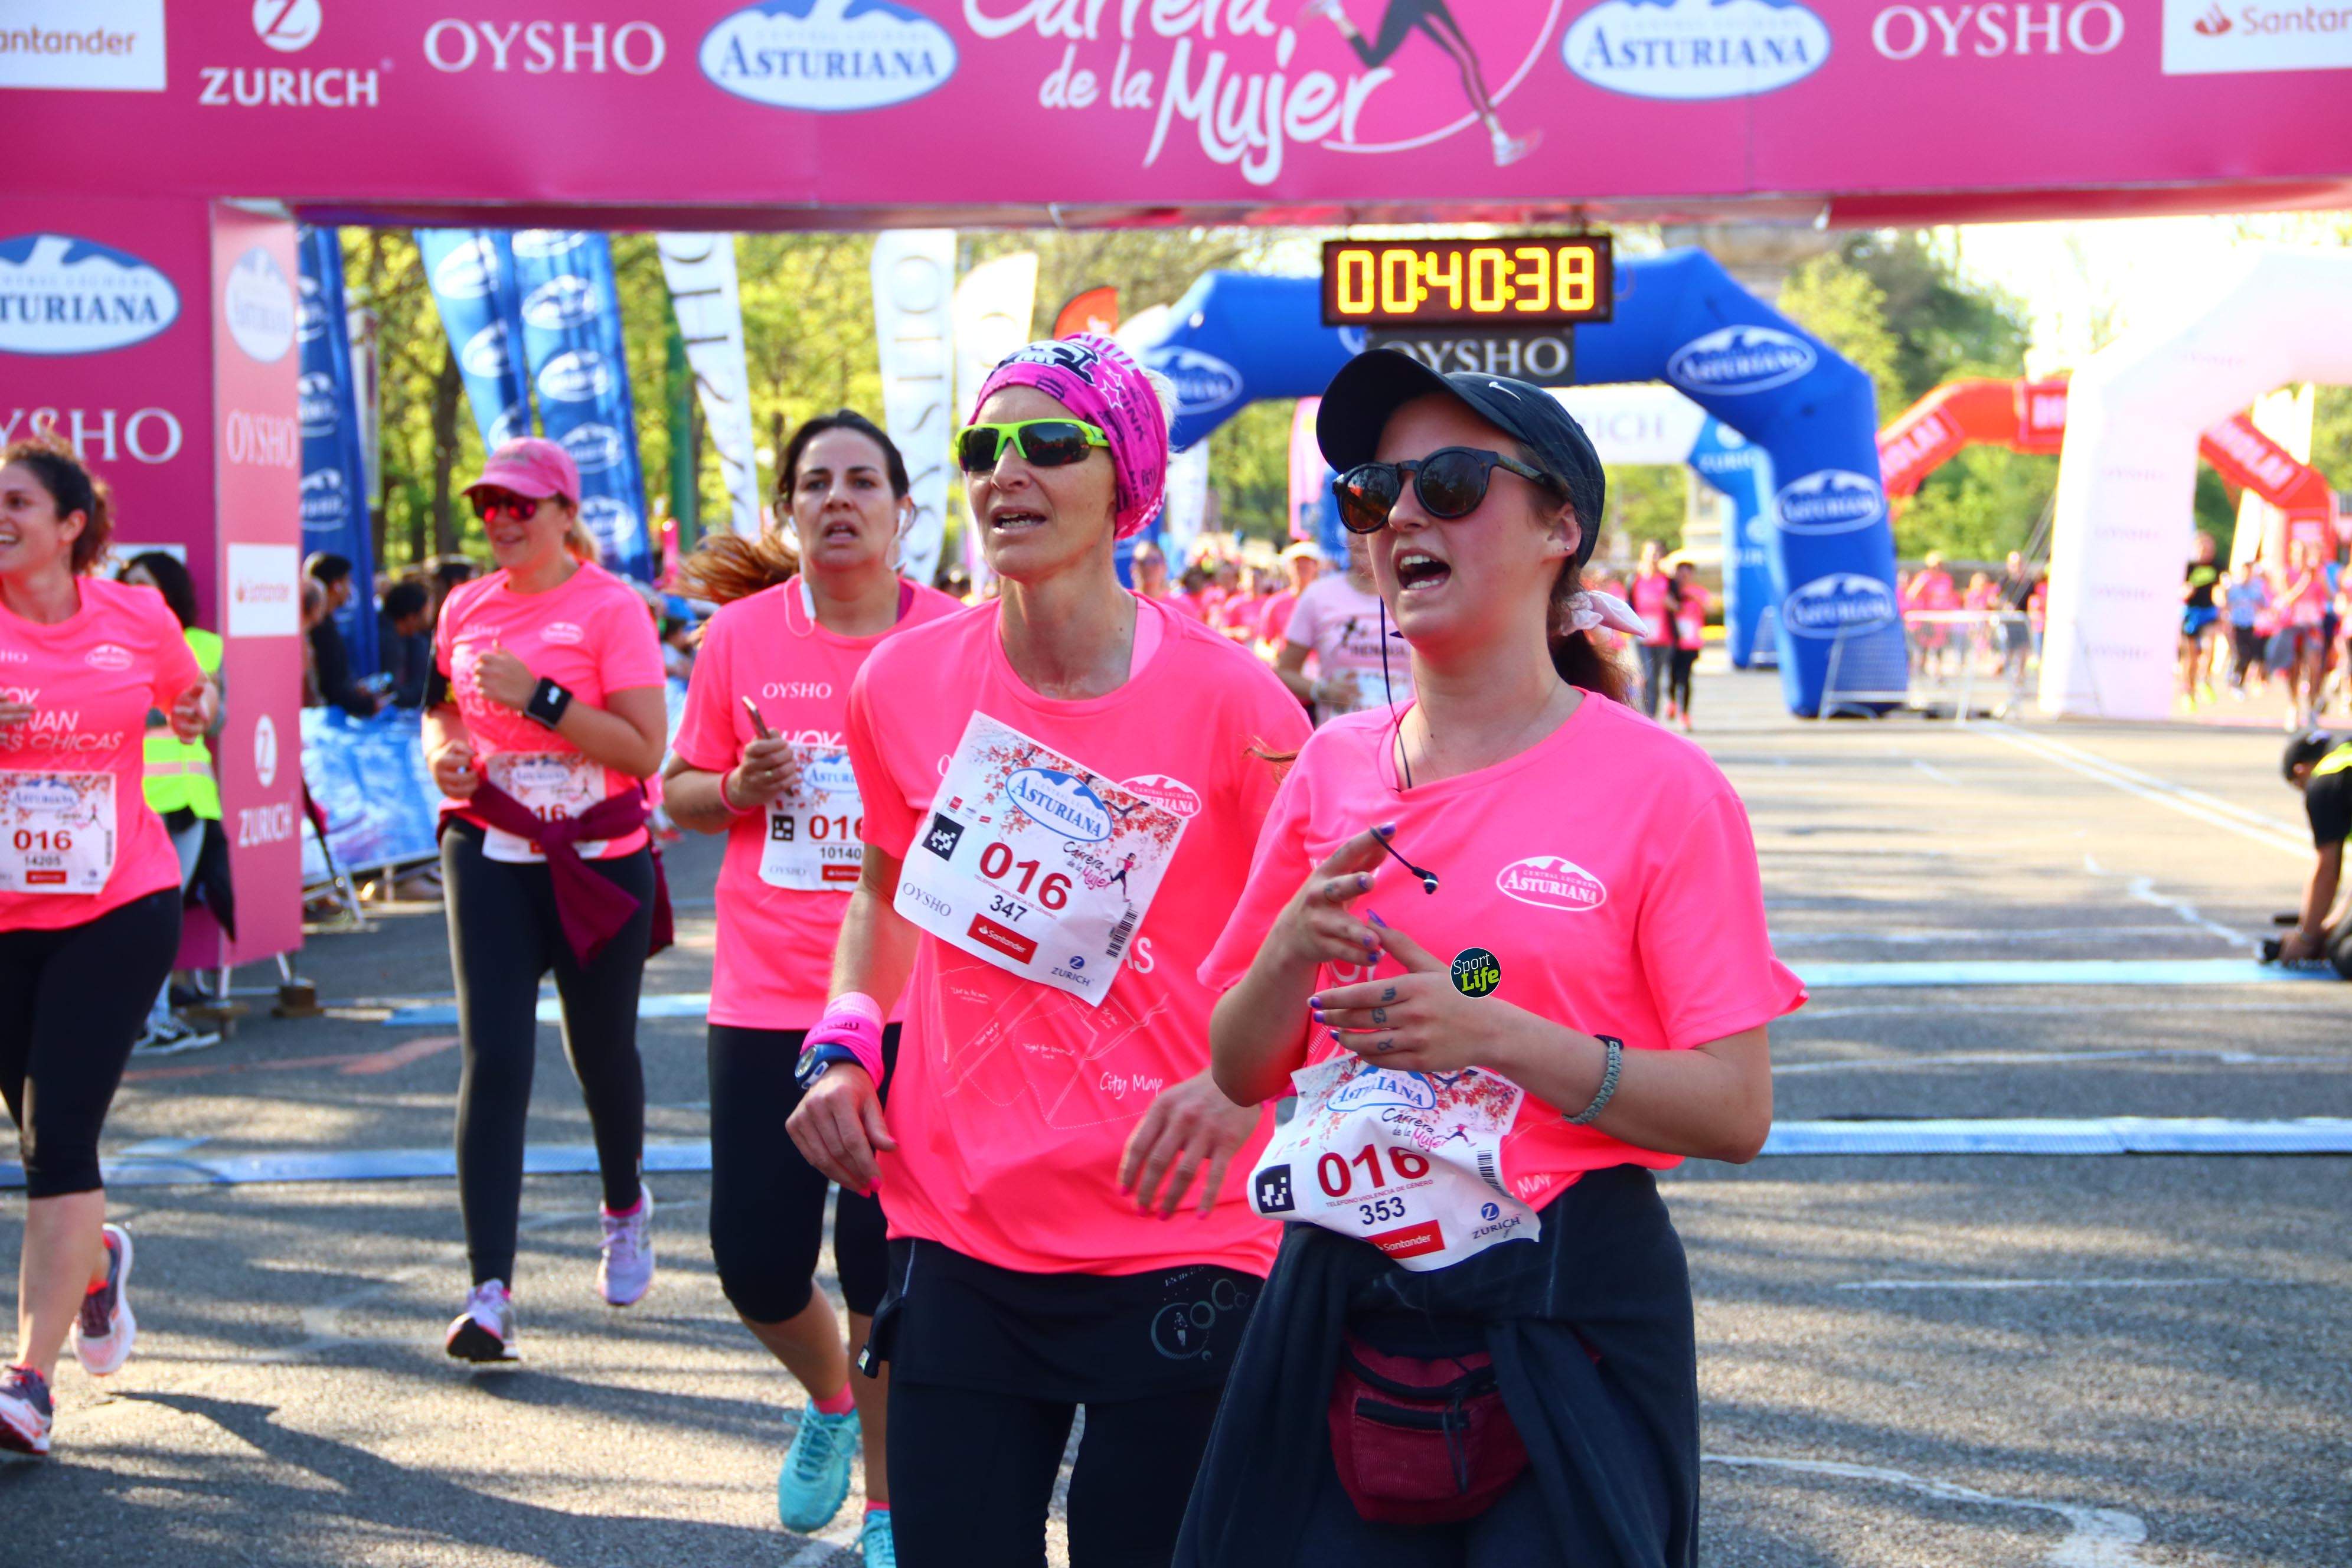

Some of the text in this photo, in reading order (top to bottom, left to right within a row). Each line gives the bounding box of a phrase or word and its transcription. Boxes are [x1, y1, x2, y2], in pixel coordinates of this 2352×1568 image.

[423, 18, 666, 74] OYSHO
[1871, 4, 2125, 60] OYSHO
[720, 34, 937, 79] ASTURIANA
[1583, 28, 1808, 70] ASTURIANA
[199, 67, 379, 107] ZURICH
[1039, 43, 1154, 109] de la
[1142, 27, 1394, 185] Mujer
[1337, 246, 1595, 315] 00:40:38
[762, 682, 832, 699] OYSHO
[30, 731, 125, 752] CHICAS
[535, 803, 568, 821] 16
[1011, 776, 1102, 838] ASTURIANA
[13, 828, 73, 851] 016
[238, 803, 293, 848] ZURICH
[820, 847, 862, 860] 10140
[1063, 841, 1104, 871] Carrera
[979, 841, 1074, 911] 016
[1077, 865, 1115, 890] Mujer
[1503, 869, 1597, 905] ASTURIANA
[1523, 869, 1559, 880] CENTRAL
[902, 881, 952, 918] OYSHO
[989, 894, 1028, 922] 347
[987, 926, 1027, 955] Santander
[1051, 966, 1091, 988] ZURICH
[1099, 1071, 1127, 1100] City
[1381, 1108, 1435, 1133] Carrera
[1410, 1126, 1448, 1152] Mujer
[1317, 1144, 1430, 1198] 016
[1359, 1196, 1406, 1226] 353
[1383, 1234, 1432, 1251] Santander
[1472, 1215, 1521, 1240] ZURICH
